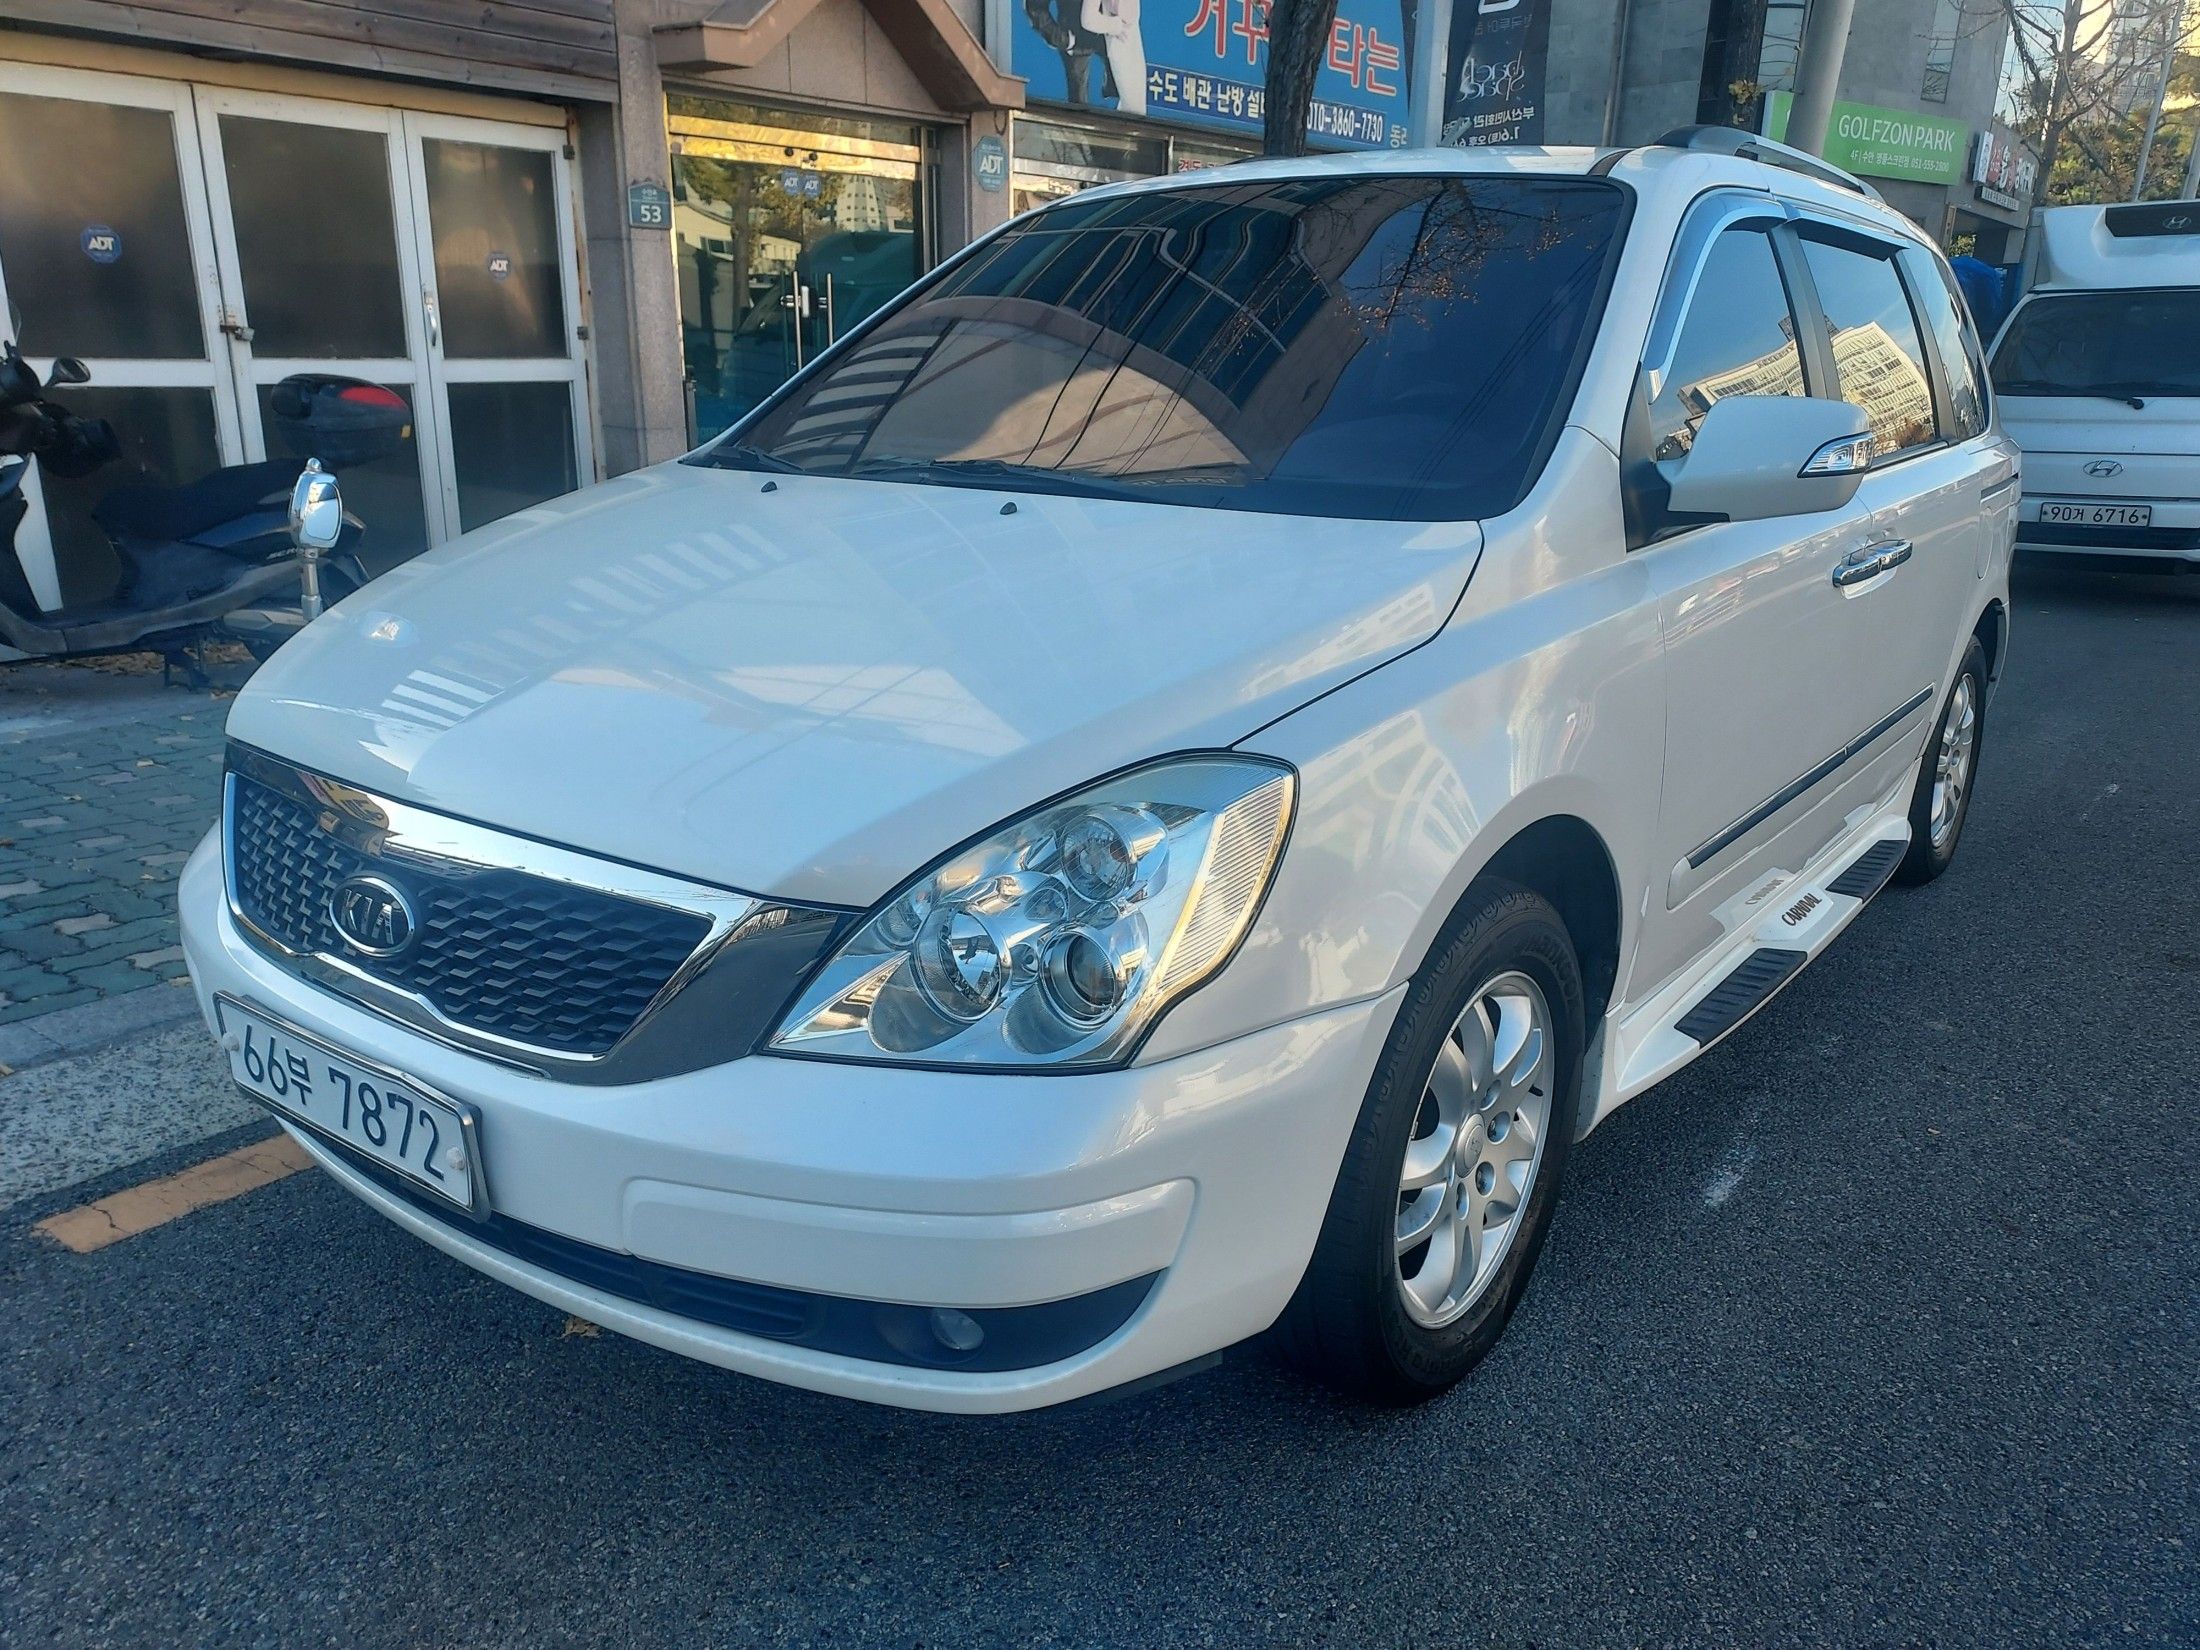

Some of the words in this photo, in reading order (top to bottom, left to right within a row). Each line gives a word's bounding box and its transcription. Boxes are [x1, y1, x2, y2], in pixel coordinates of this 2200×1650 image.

[1327, 16, 1399, 96] 타는
[1149, 71, 1178, 102] 수도
[1183, 76, 1211, 109] 배관
[1217, 83, 1244, 116] 난방
[980, 155, 1003, 174] ADT
[784, 177, 798, 187] ADT
[805, 180, 819, 190] ADT
[640, 205, 662, 223] 53
[89, 236, 114, 250] ADT
[490, 260, 508, 271] ADT
[2092, 508, 2139, 524] 6716
[1782, 892, 1822, 926] CARNIVAL
[244, 1024, 312, 1106] 66부
[328, 1066, 445, 1182] 7872
